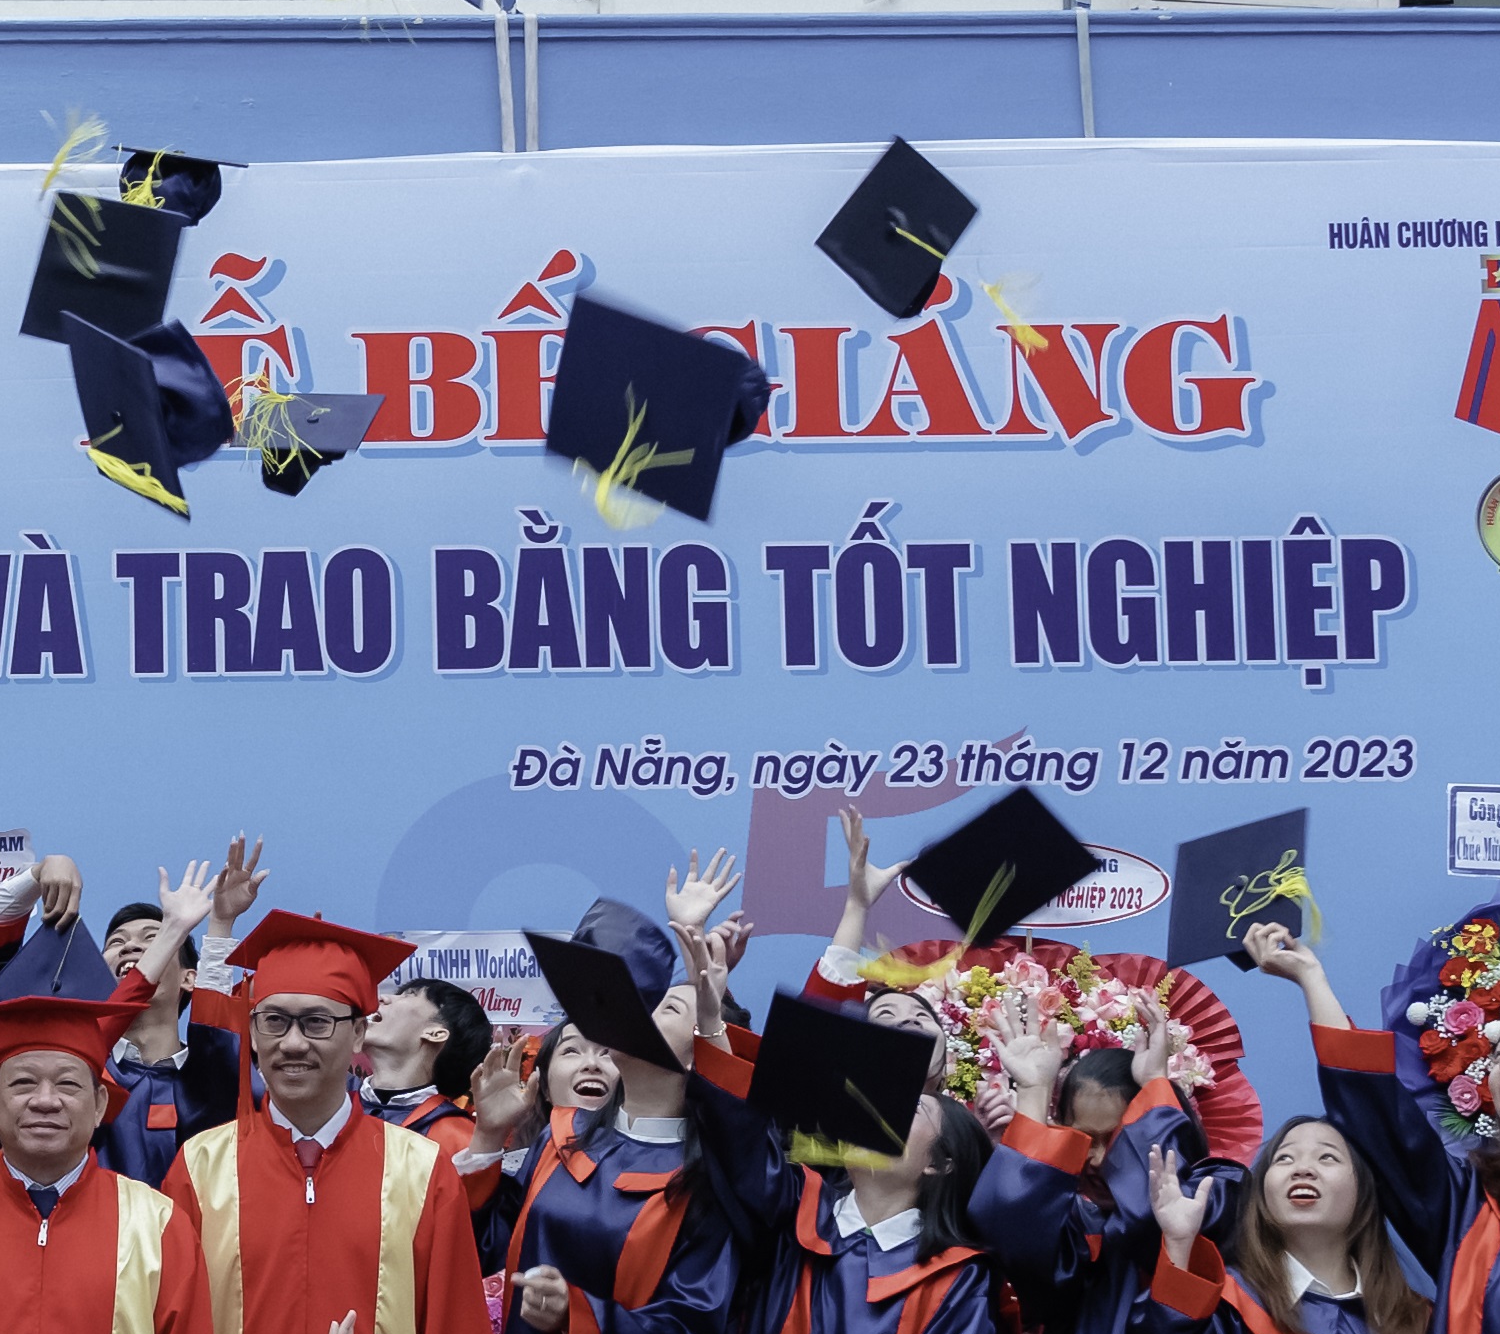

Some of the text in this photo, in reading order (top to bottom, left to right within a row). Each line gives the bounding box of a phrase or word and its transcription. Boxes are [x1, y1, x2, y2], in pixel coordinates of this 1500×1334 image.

[1328, 217, 1391, 250] HUÂN
[1399, 218, 1489, 249] CHƯƠNG
[114, 547, 396, 676] TRAO
[433, 508, 733, 672] BẰNG
[765, 500, 973, 668] TỐT
[1008, 514, 1407, 687] NGHIỆP
[511, 738, 1415, 796] Đà Nẵng, ngày 23 tháng 12 năm 2023
[1057, 881, 1143, 914] NGHIỆP 2023
[428, 949, 471, 978] TNHH
[470, 987, 522, 1017] Mừng
